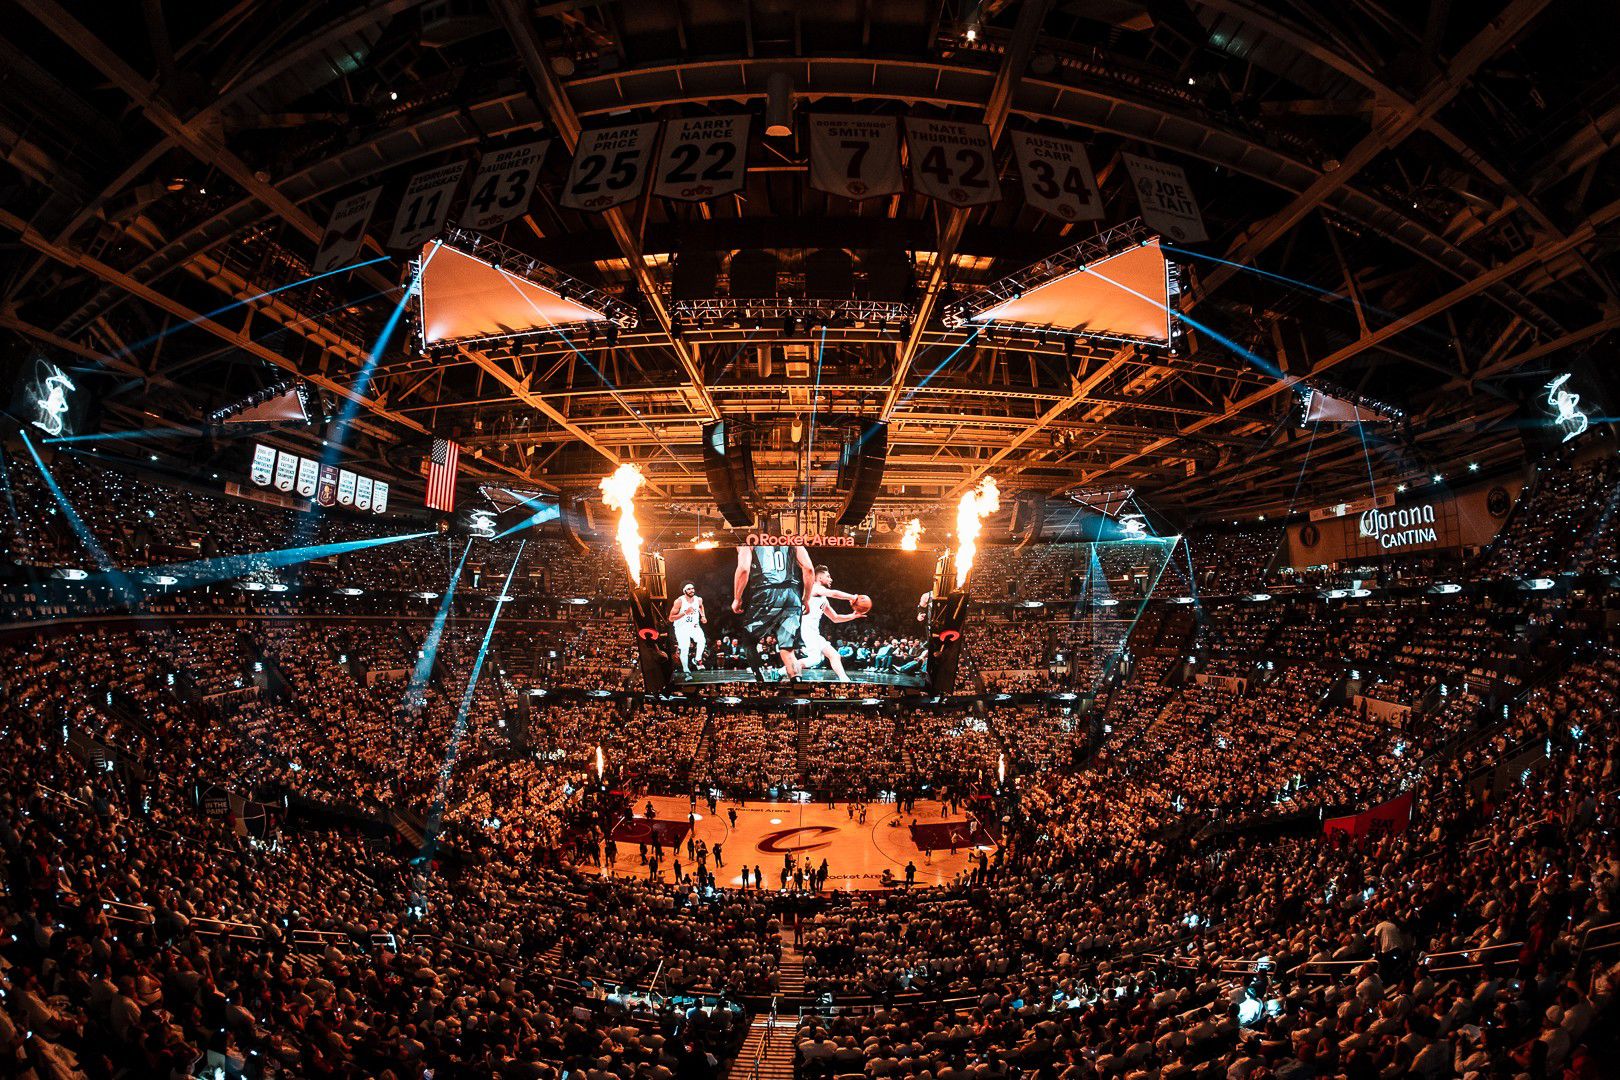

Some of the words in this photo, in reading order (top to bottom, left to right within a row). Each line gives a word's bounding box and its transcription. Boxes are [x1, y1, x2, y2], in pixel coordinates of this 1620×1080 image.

[597, 129, 639, 141] MARK
[680, 129, 733, 141] NANCE
[683, 119, 734, 131] LARRY
[828, 127, 880, 138] SMITH
[929, 123, 966, 135] NATE
[593, 138, 638, 151] PRICE
[911, 130, 986, 147] THURMOND
[1025, 136, 1074, 153] AUSTIN
[477, 154, 542, 175] DAUGHERTY
[495, 148, 531, 162] BRAD
[665, 141, 737, 183] 22
[840, 140, 870, 179] 7
[1034, 148, 1072, 162] CARR
[571, 150, 641, 194] 25
[921, 146, 990, 188] 42
[471, 169, 530, 213] 43
[1028, 159, 1093, 205] 34
[1155, 179, 1187, 199] JOE
[400, 190, 443, 235] 11
[1155, 192, 1193, 215] TAIT
[1359, 504, 1435, 540] Corona
[760, 533, 809, 546] Rocket
[812, 533, 855, 546] Arena
[1381, 527, 1437, 549] CANTINA
